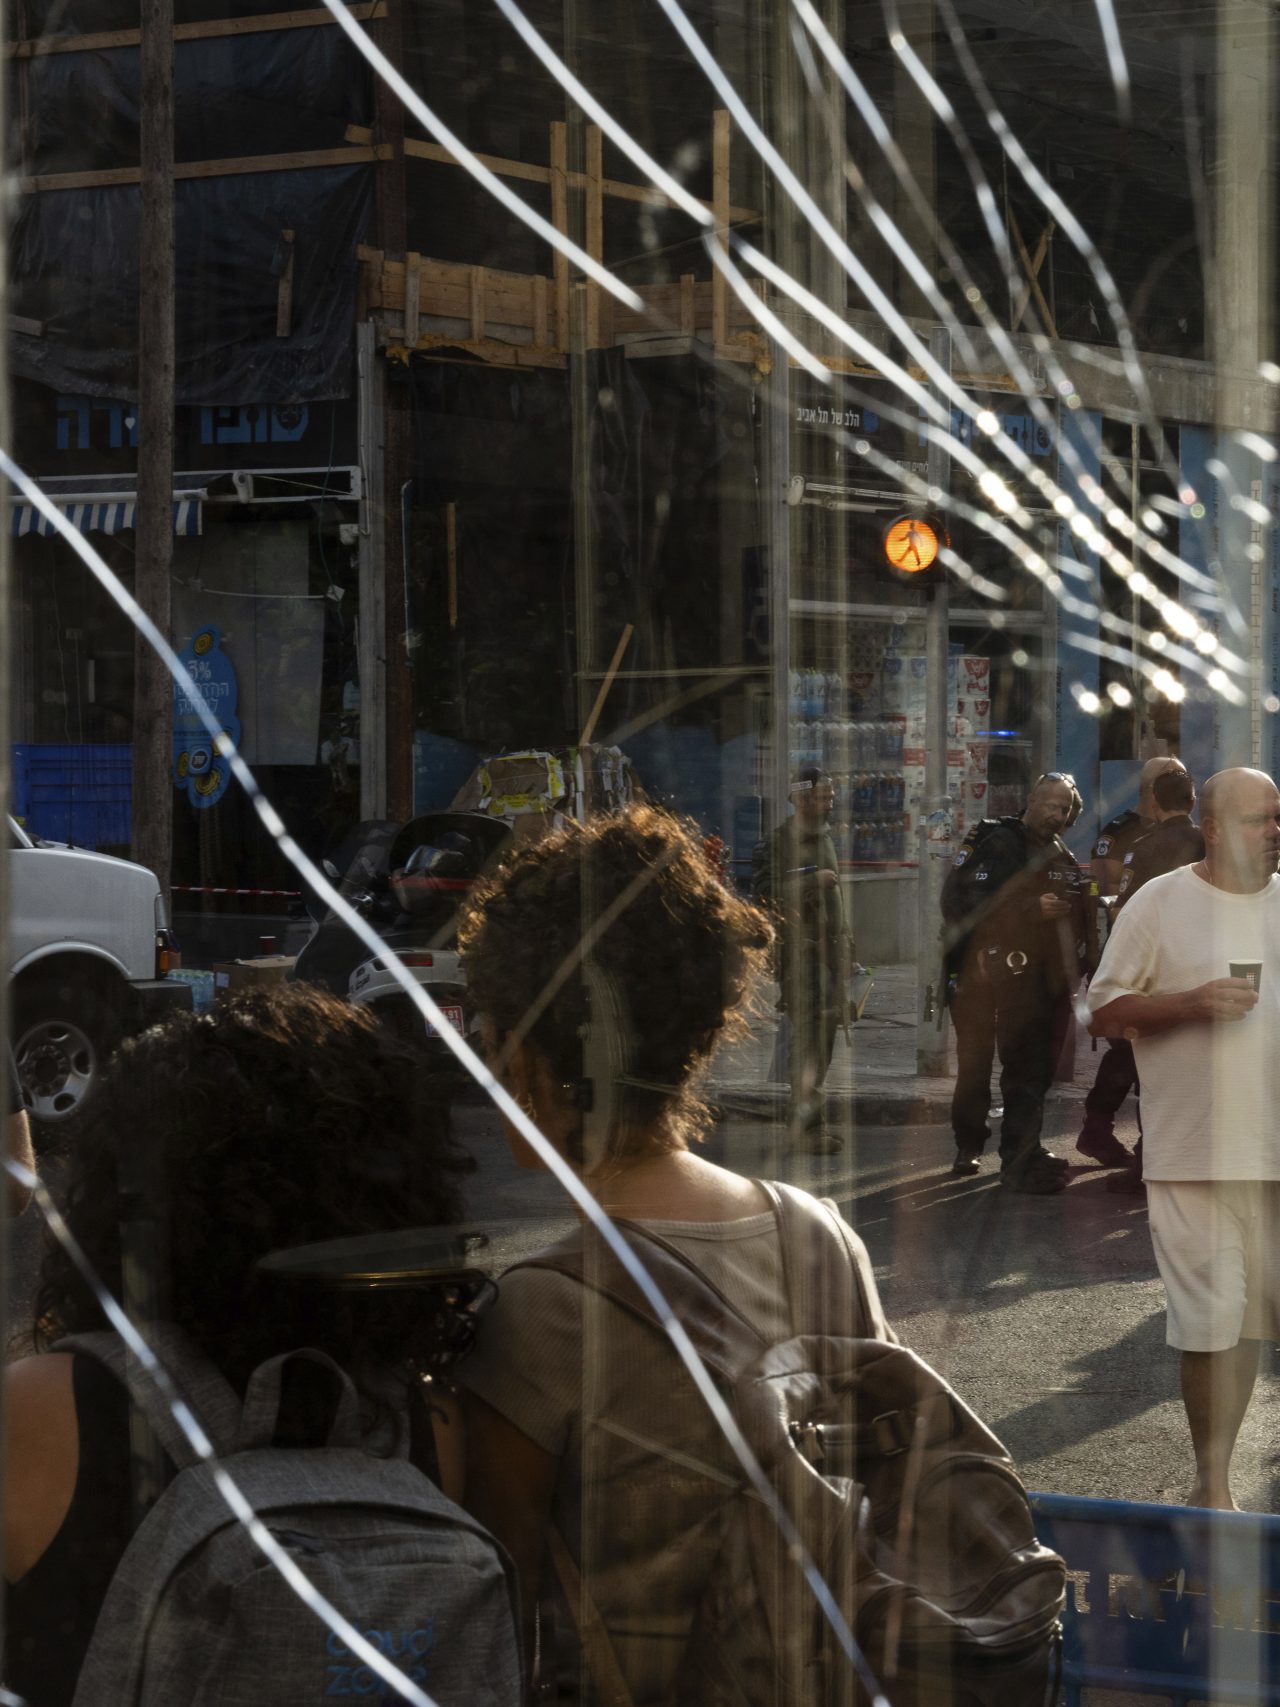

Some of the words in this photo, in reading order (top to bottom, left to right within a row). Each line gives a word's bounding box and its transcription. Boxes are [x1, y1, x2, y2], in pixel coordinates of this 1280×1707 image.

[56, 396, 139, 449] ודה
[796, 407, 816, 423] אביב
[817, 406, 829, 424] תל
[831, 408, 843, 425] של
[844, 409, 860, 428] הלב
